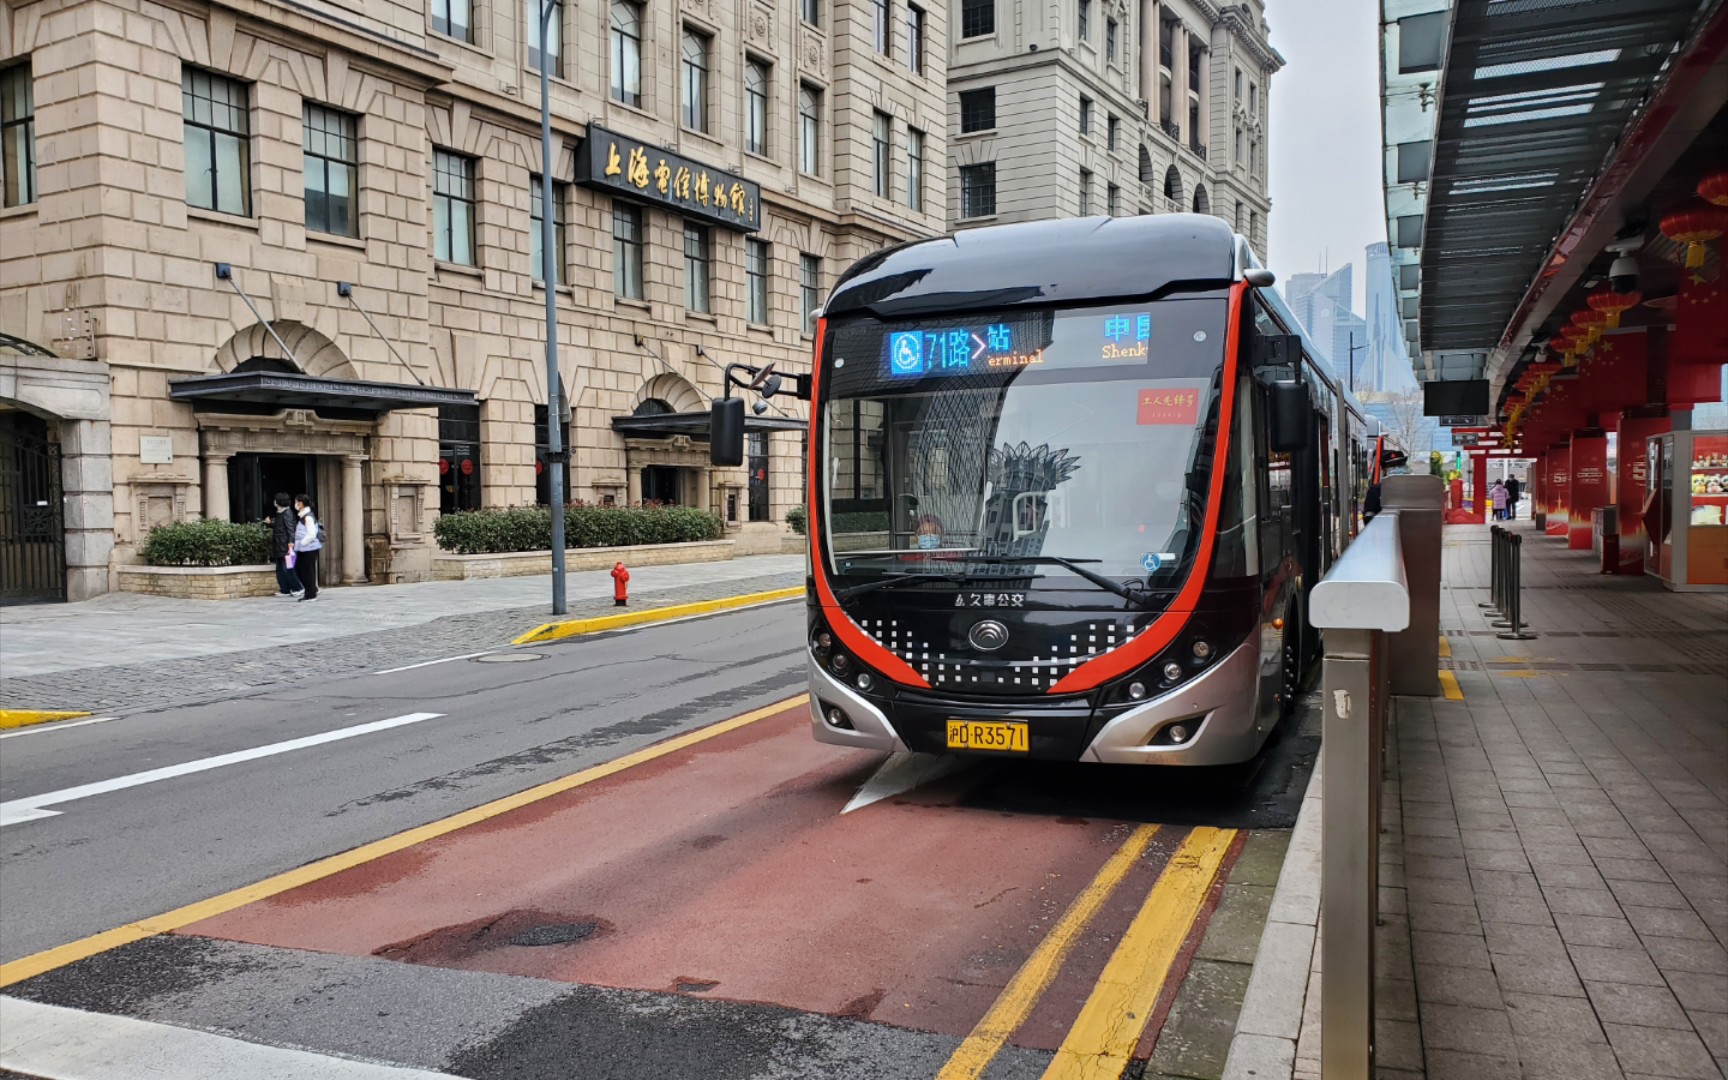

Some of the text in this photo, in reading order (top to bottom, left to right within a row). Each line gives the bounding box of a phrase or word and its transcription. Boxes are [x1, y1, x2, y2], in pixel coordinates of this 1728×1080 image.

[987, 323, 1010, 350] 站
[988, 349, 1044, 367] erminal
[1102, 341, 1149, 359] Shenk
